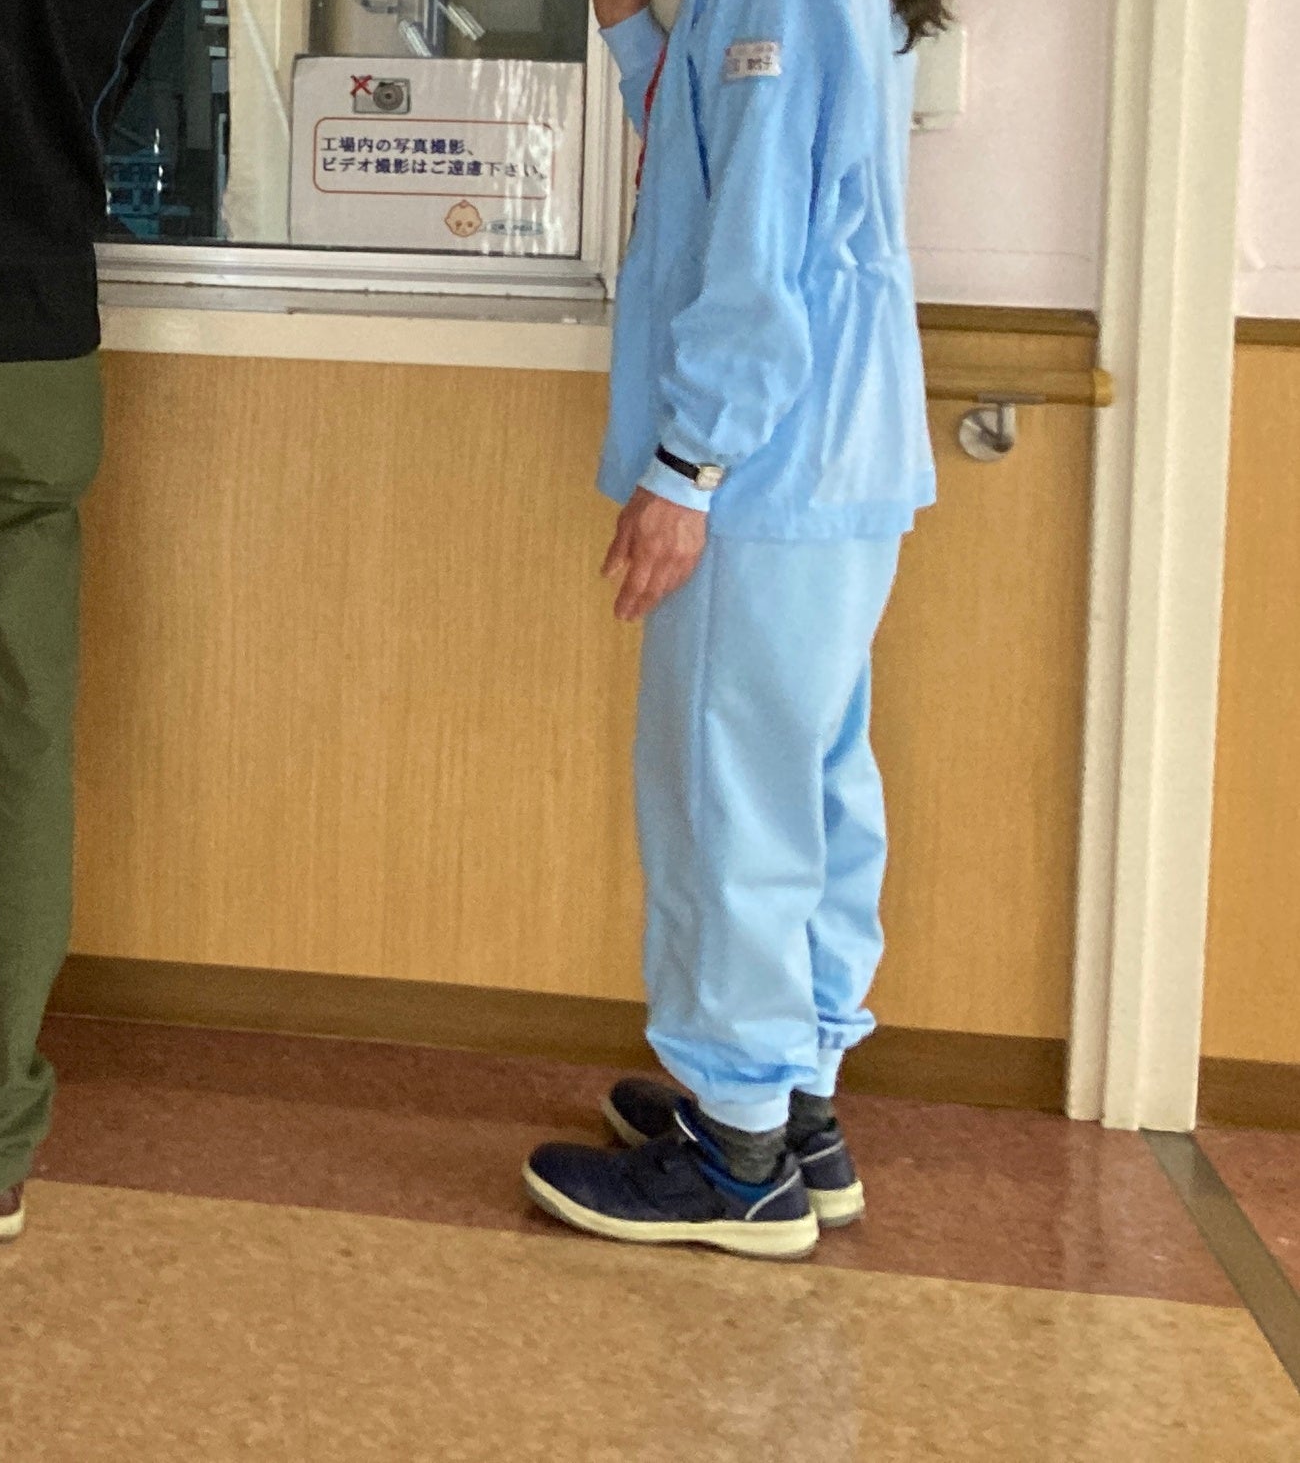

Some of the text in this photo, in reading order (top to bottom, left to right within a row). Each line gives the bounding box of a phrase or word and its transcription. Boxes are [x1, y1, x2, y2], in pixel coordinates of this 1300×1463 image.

[320, 137, 474, 156] 工場内の写真撮影、
